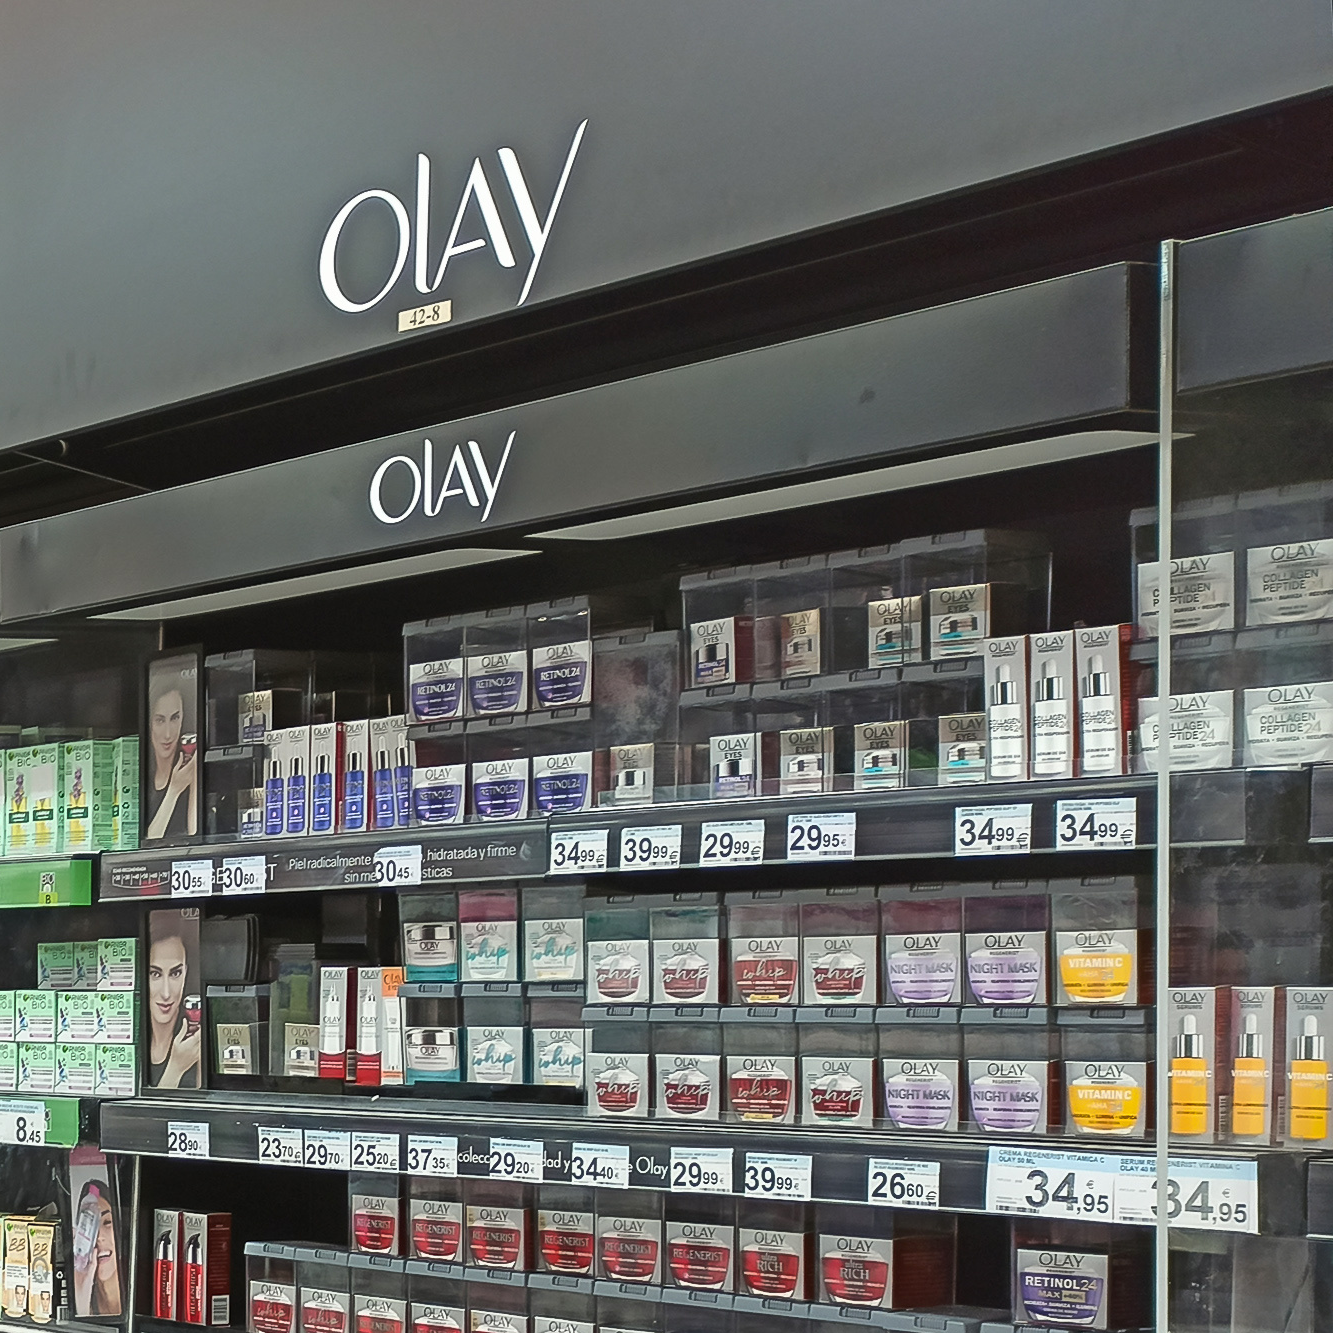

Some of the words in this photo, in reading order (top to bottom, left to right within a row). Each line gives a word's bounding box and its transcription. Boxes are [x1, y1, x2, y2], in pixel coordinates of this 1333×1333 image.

[409, 305, 440, 326] 42-8
[546, 646, 574, 659] OLAY
[1267, 687, 1316, 704] OLAY
[1260, 714, 1318, 727] COLLAGEN
[904, 936, 941, 949] OLAY
[1075, 933, 1115, 947] OLAY
[890, 961, 922, 974] NIGHT
[925, 959, 955, 973] MASK
[1069, 958, 1113, 968] VITAMIN
[1024, 1151, 1064, 1160] REGENERIST
[1038, 1251, 1085, 1269] OLAY
[840, 1267, 870, 1281] RICH
